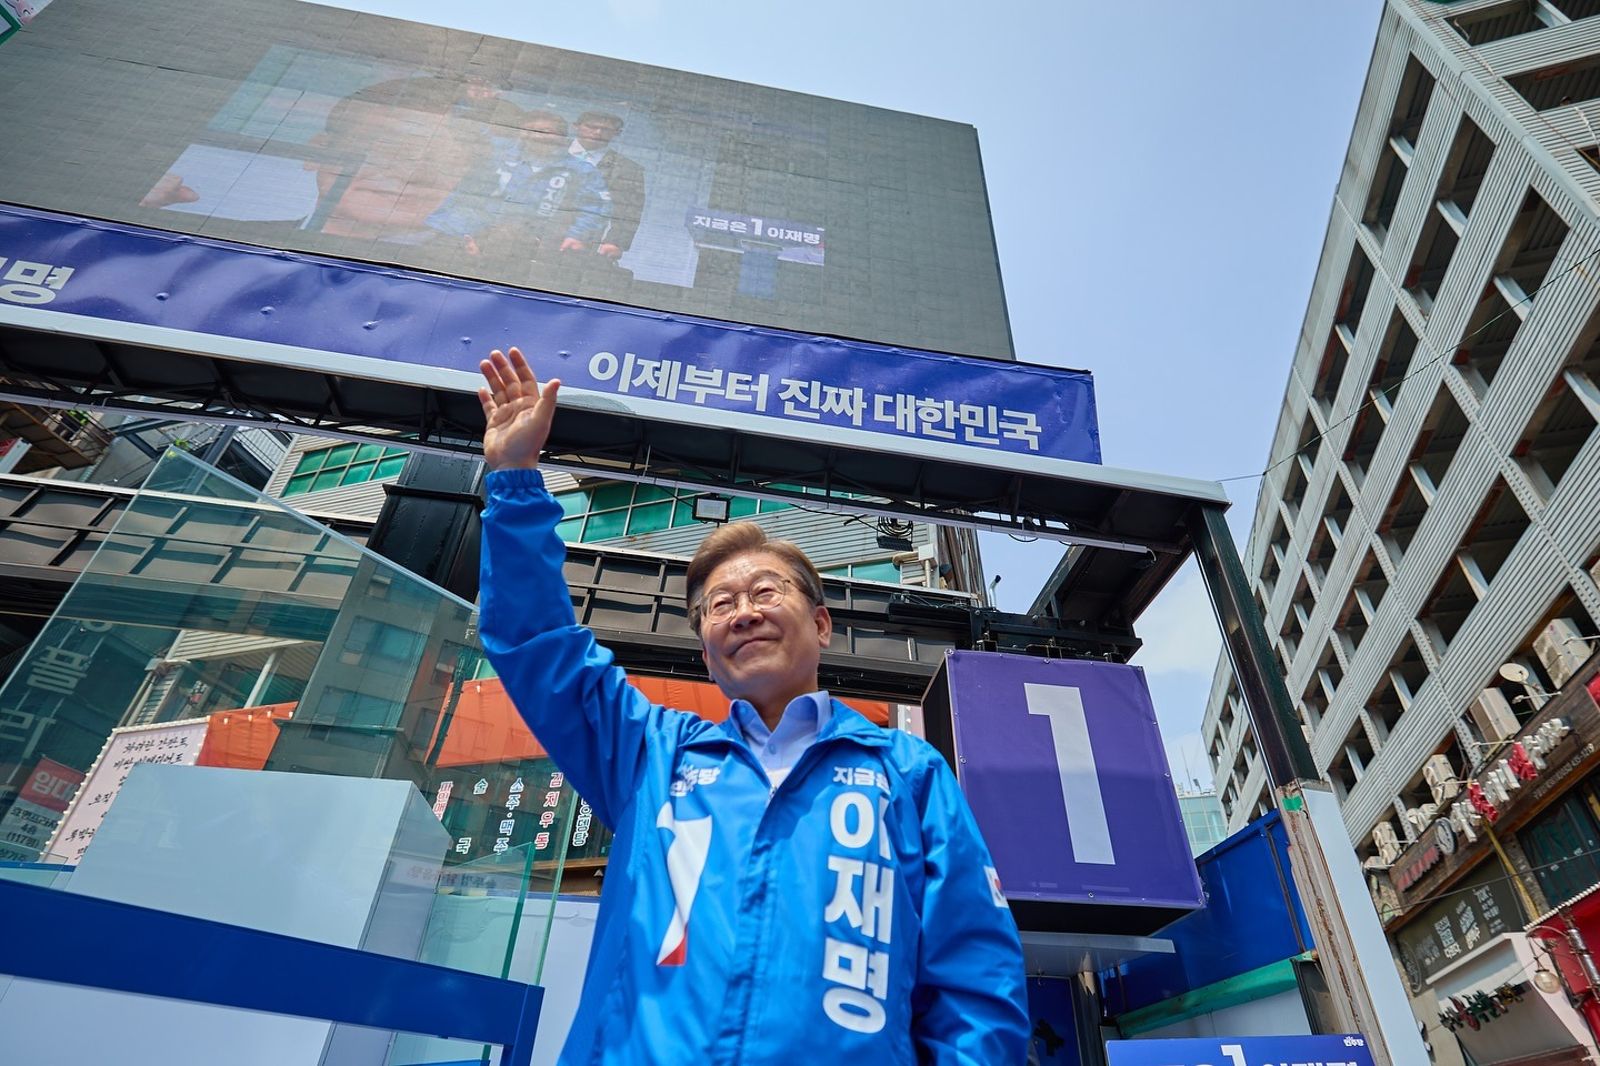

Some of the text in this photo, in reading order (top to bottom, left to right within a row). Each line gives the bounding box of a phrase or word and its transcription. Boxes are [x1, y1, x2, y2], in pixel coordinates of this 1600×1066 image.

[693, 215, 821, 245] 지금은 1 이재명
[0, 257, 75, 305] 명
[588, 351, 1042, 451] 이제부터 진짜 대한민국
[534, 772, 564, 850] 김치우동
[1024, 683, 1116, 866] 1
[572, 797, 592, 847] 오뎅탕
[822, 792, 895, 1034] 이재명
